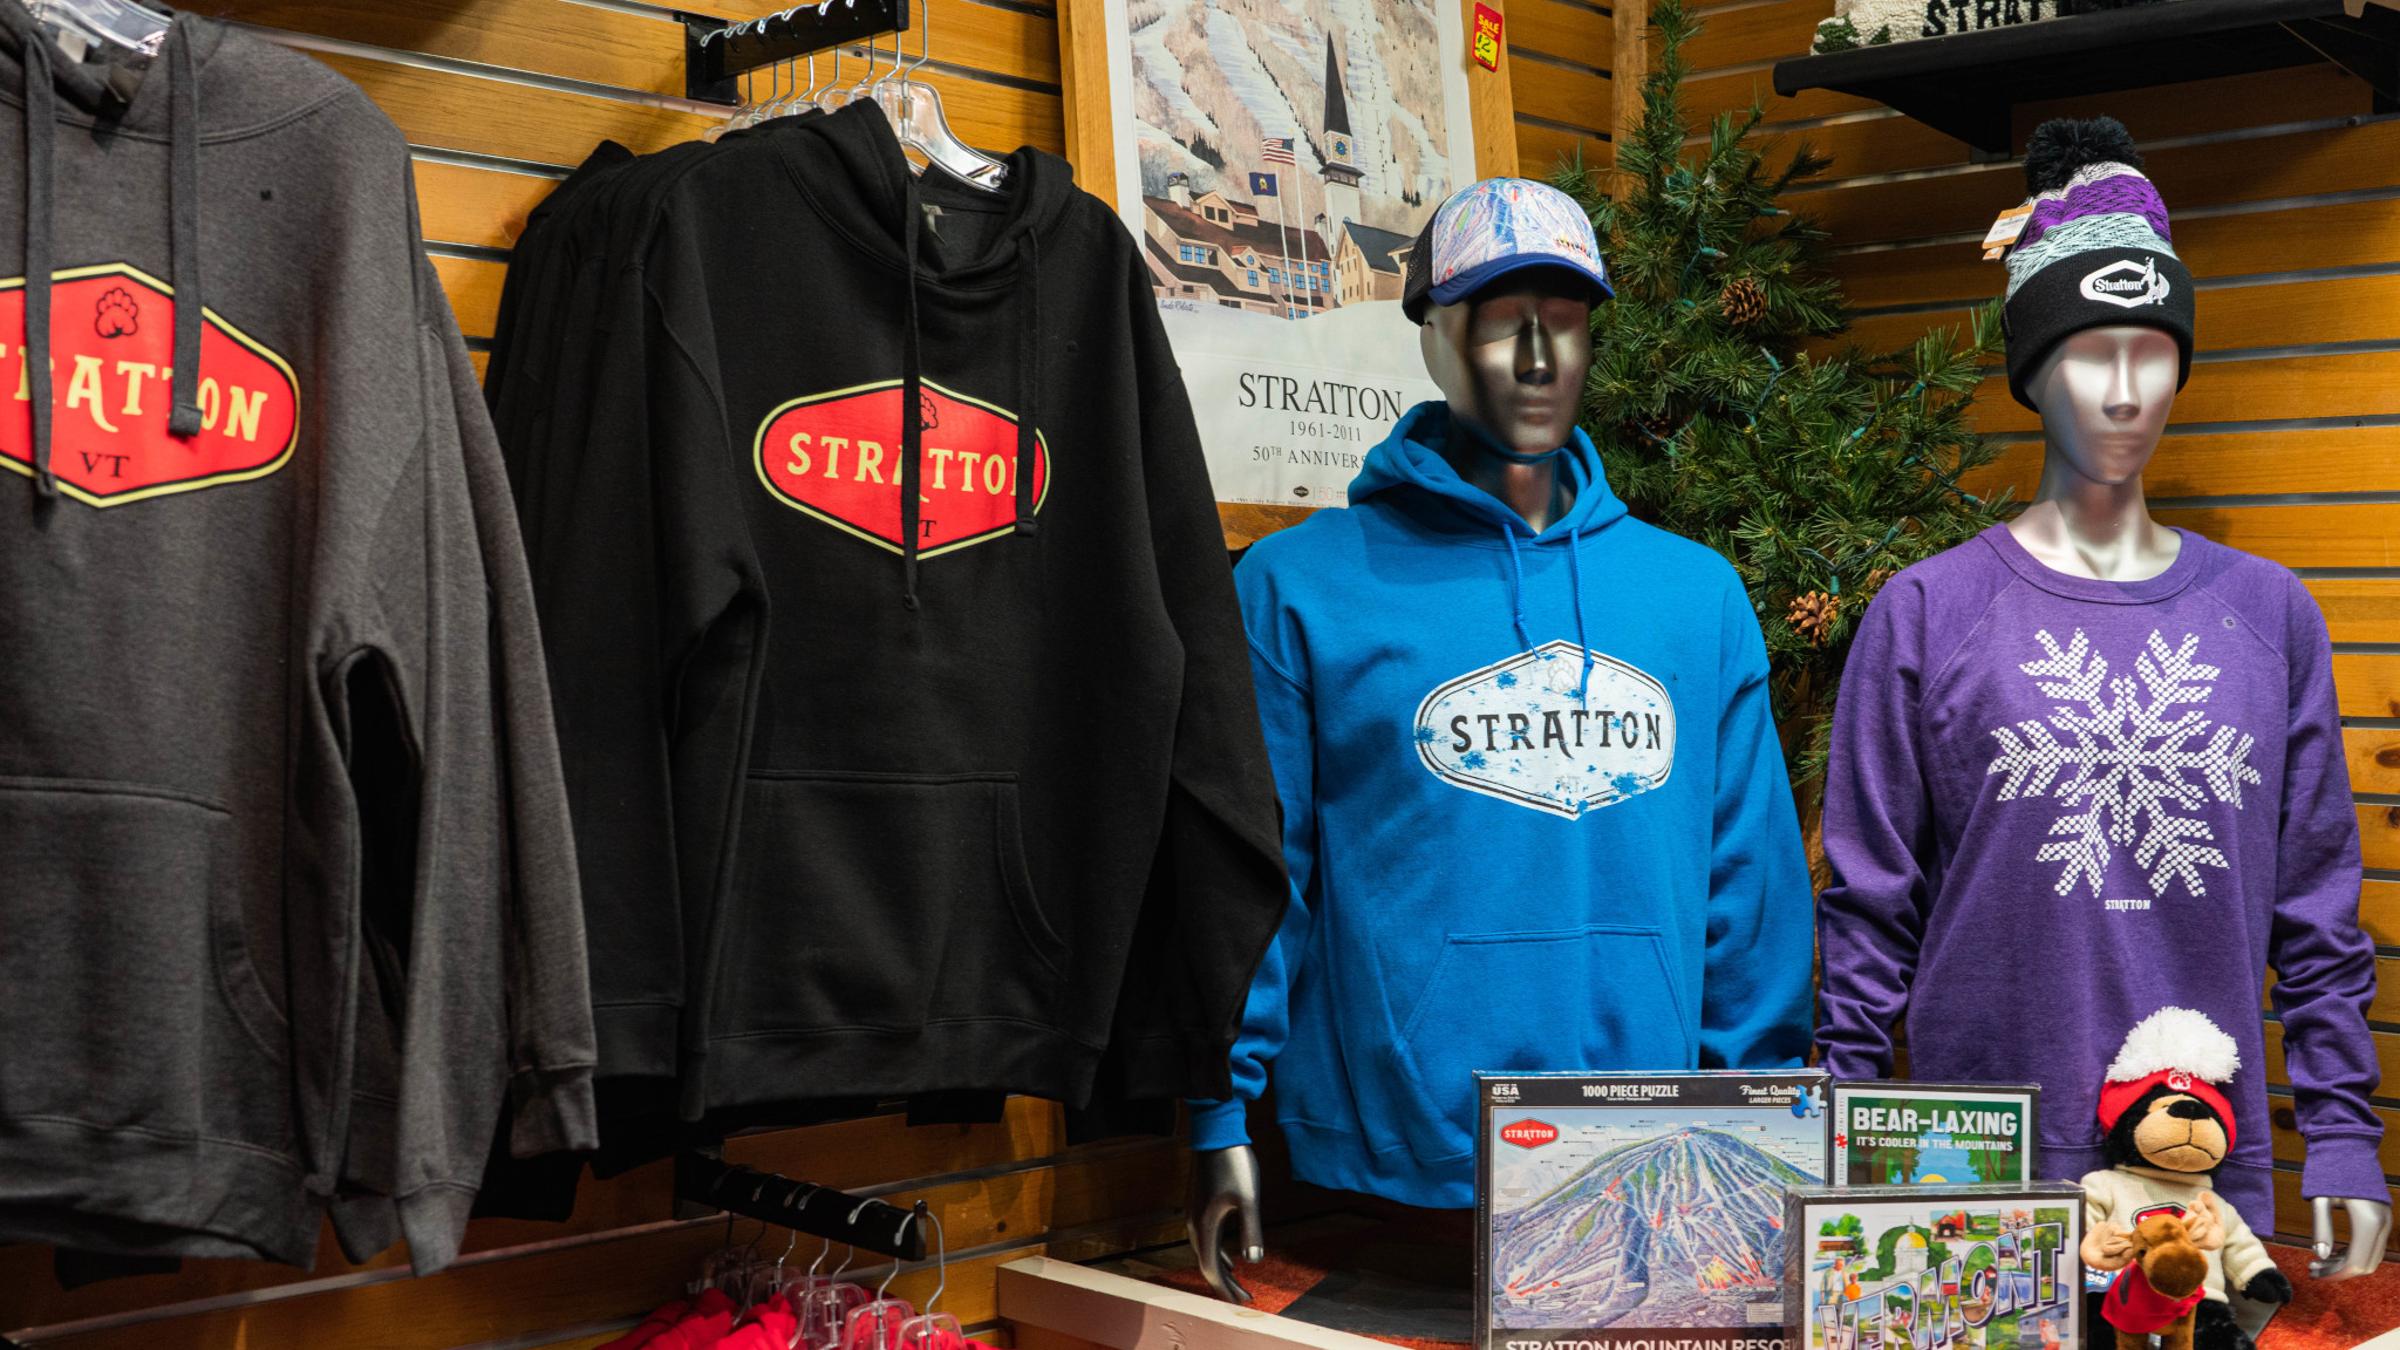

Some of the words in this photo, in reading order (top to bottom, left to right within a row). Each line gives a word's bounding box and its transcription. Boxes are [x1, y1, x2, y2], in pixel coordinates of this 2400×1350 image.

[1238, 372, 1402, 421] STRATTON
[1290, 420, 1362, 442] 1961-2011
[80, 451, 130, 478] VT
[786, 432, 1018, 503] STRTTO
[1287, 449, 1366, 469] ANNIVER
[1450, 709, 1662, 760] STRATTON
[2105, 900, 2151, 912] STRATTON
[1492, 1086, 1520, 1096] USA
[1582, 1085, 1608, 1097] 1000
[1609, 1085, 1639, 1097] PIECE
[1641, 1085, 1679, 1097] PUZZLE
[1853, 1107, 2018, 1136] BEAR-LAXING
[1504, 1130, 1554, 1140] STRATTON
[1856, 1136, 1876, 1147] IT'S
[1878, 1137, 1917, 1148] COOLER
[1918, 1138, 1930, 1149] IN
[1932, 1139, 1953, 1150] THE
[1954, 1140, 2014, 1151] MOUNTAINS
[1818, 1222, 2066, 1350] VERMONT
[1505, 1340, 1609, 1350] STRATTON
[1614, 1340, 1727, 1350] MOUNTAIN
[1733, 1338, 1785, 1350] RESO
